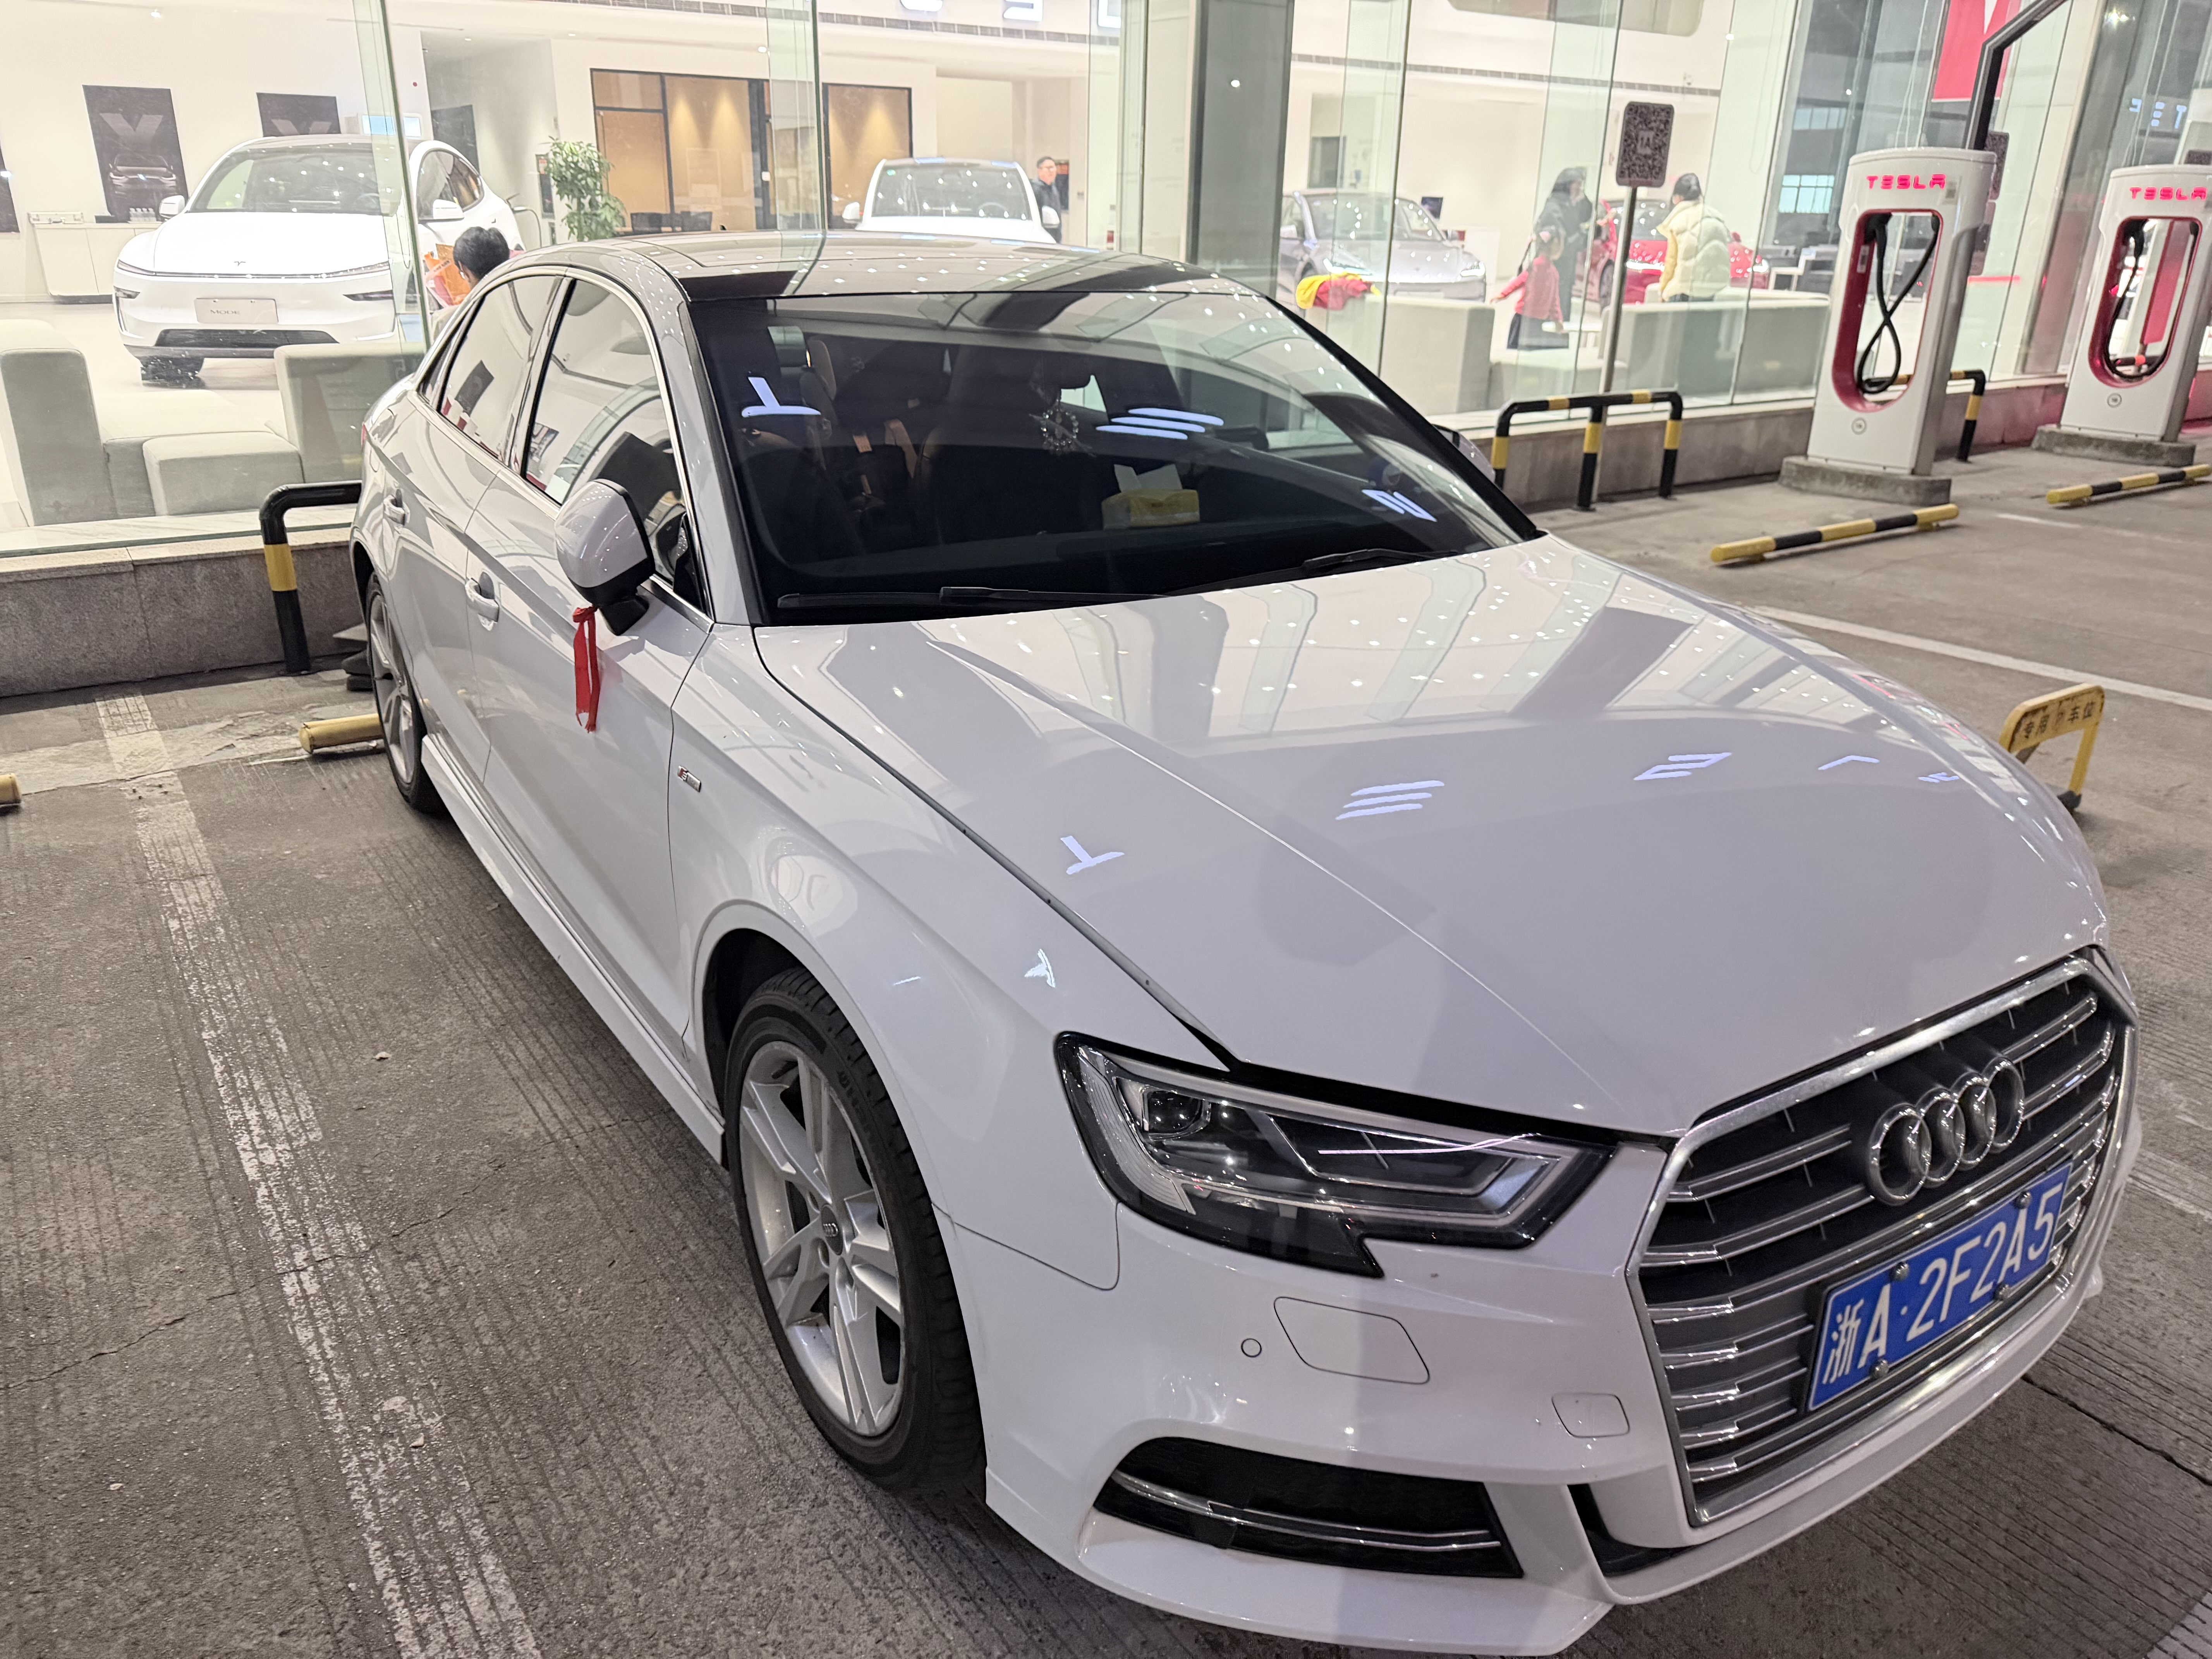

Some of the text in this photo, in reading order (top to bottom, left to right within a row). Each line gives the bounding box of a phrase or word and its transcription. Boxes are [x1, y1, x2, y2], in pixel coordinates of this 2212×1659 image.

[1866, 173, 1946, 190] TESLA
[2129, 186, 2207, 201] TESLA
[1822, 1184, 2063, 1384] 浙A·2F2A5
